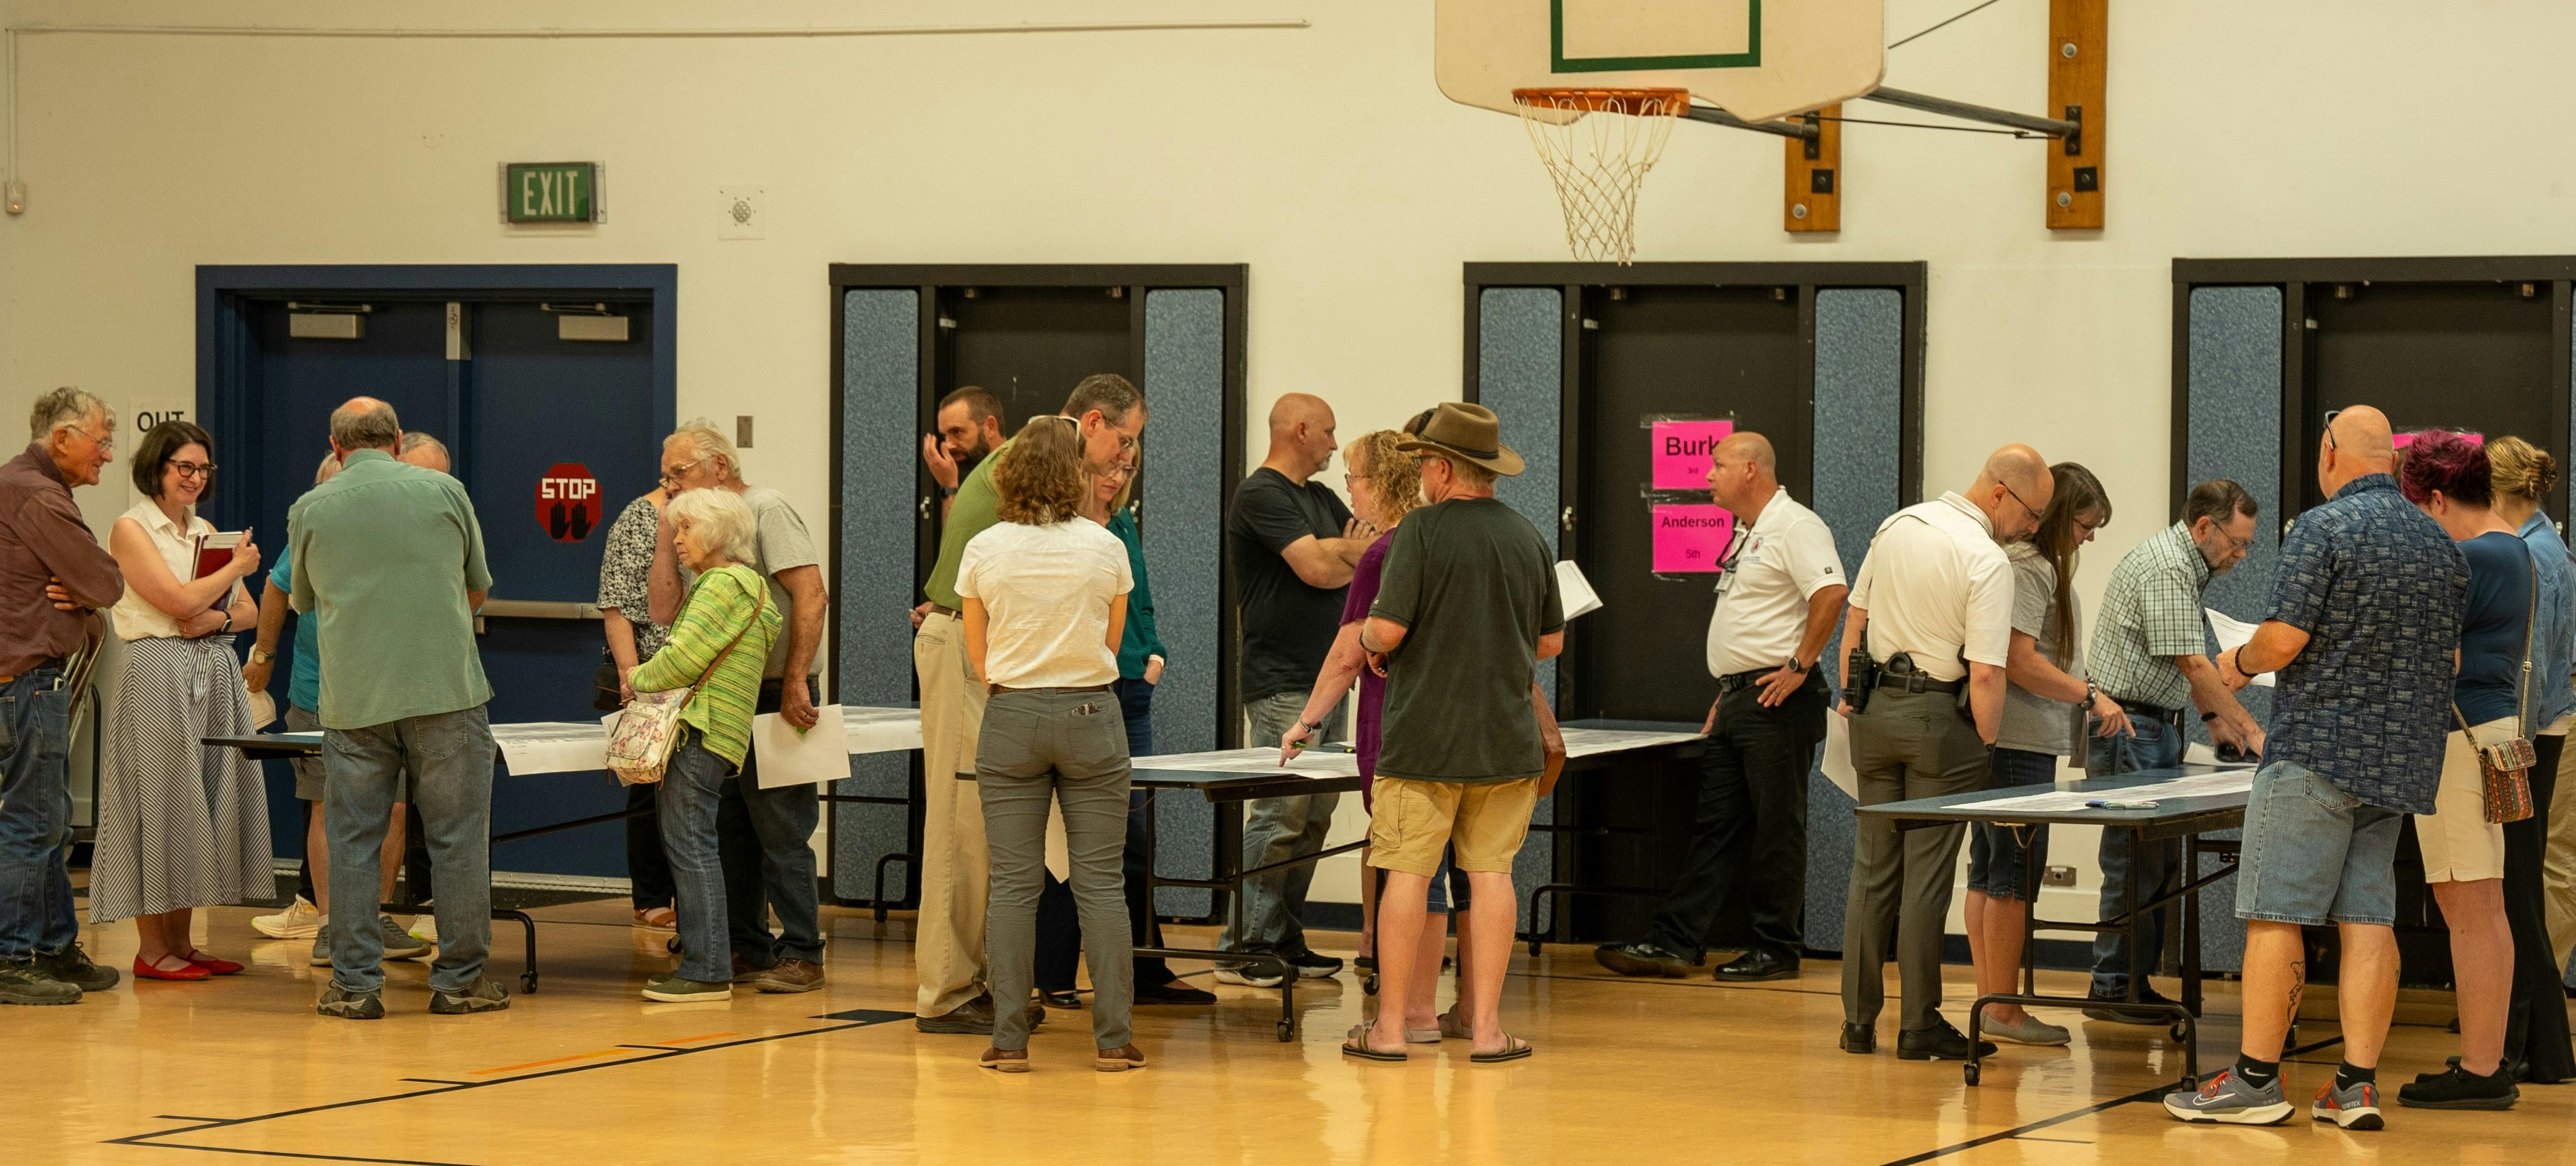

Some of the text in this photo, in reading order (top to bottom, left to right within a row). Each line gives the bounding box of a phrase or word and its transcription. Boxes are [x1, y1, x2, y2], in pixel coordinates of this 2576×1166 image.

[523, 170, 578, 216] EXIT
[541, 478, 595, 499] STOP
[1662, 516, 1725, 528] Anderson
[1685, 548, 1701, 559] 5th
